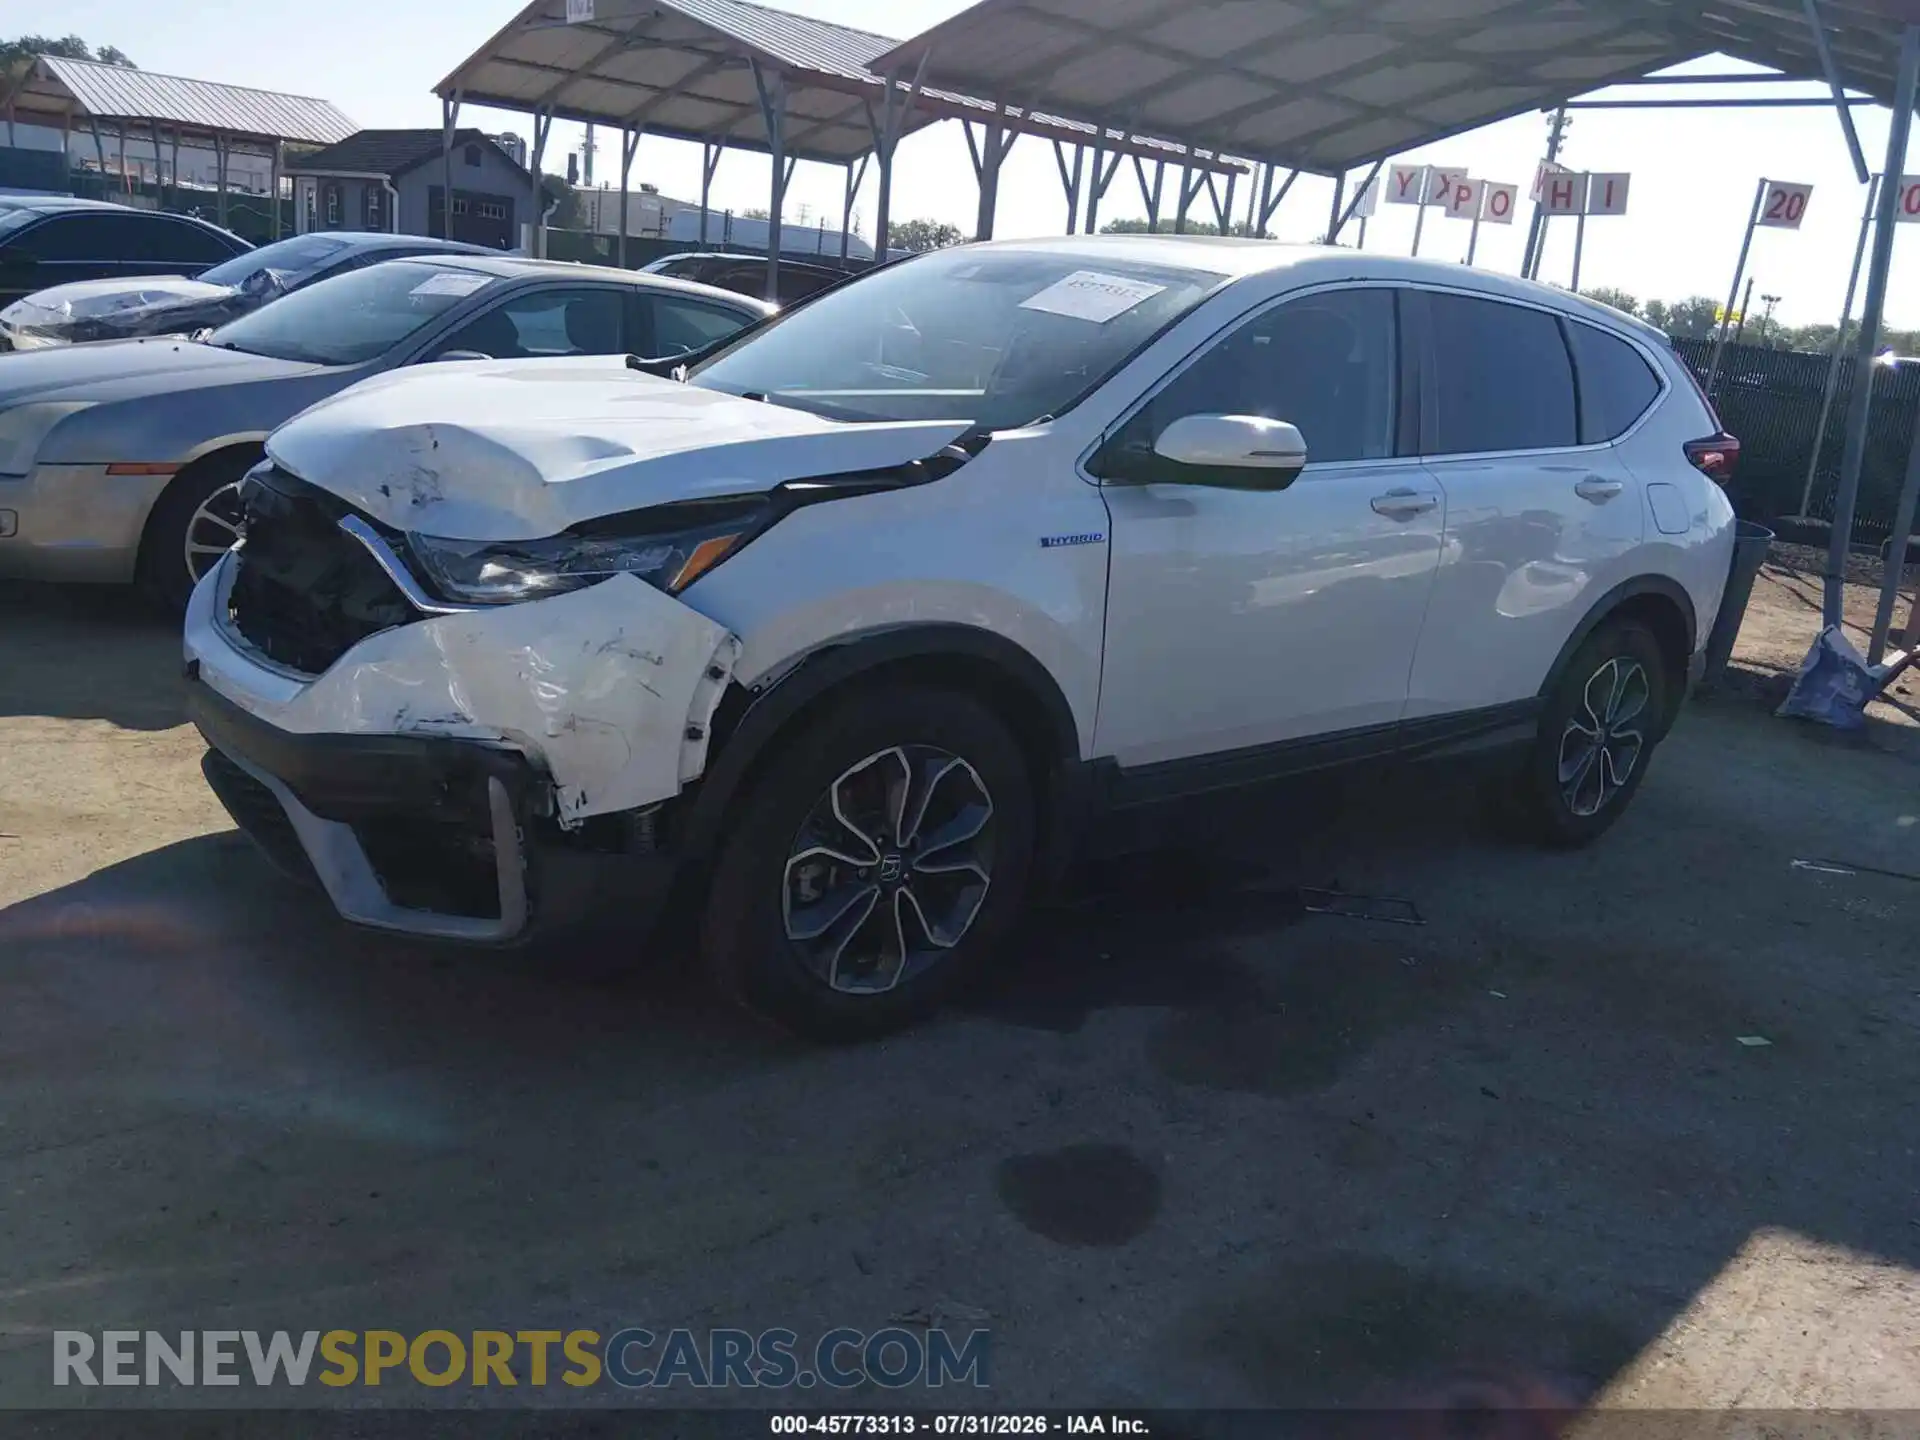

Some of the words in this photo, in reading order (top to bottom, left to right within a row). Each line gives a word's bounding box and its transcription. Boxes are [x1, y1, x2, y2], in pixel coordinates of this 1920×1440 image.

[1397, 171, 1415, 197] Y
[1551, 180, 1573, 208] H
[1453, 185, 1472, 211] P
[1766, 190, 1804, 220] 20
[1898, 183, 1920, 215] 0
[1050, 533, 1103, 545] HYBRID
